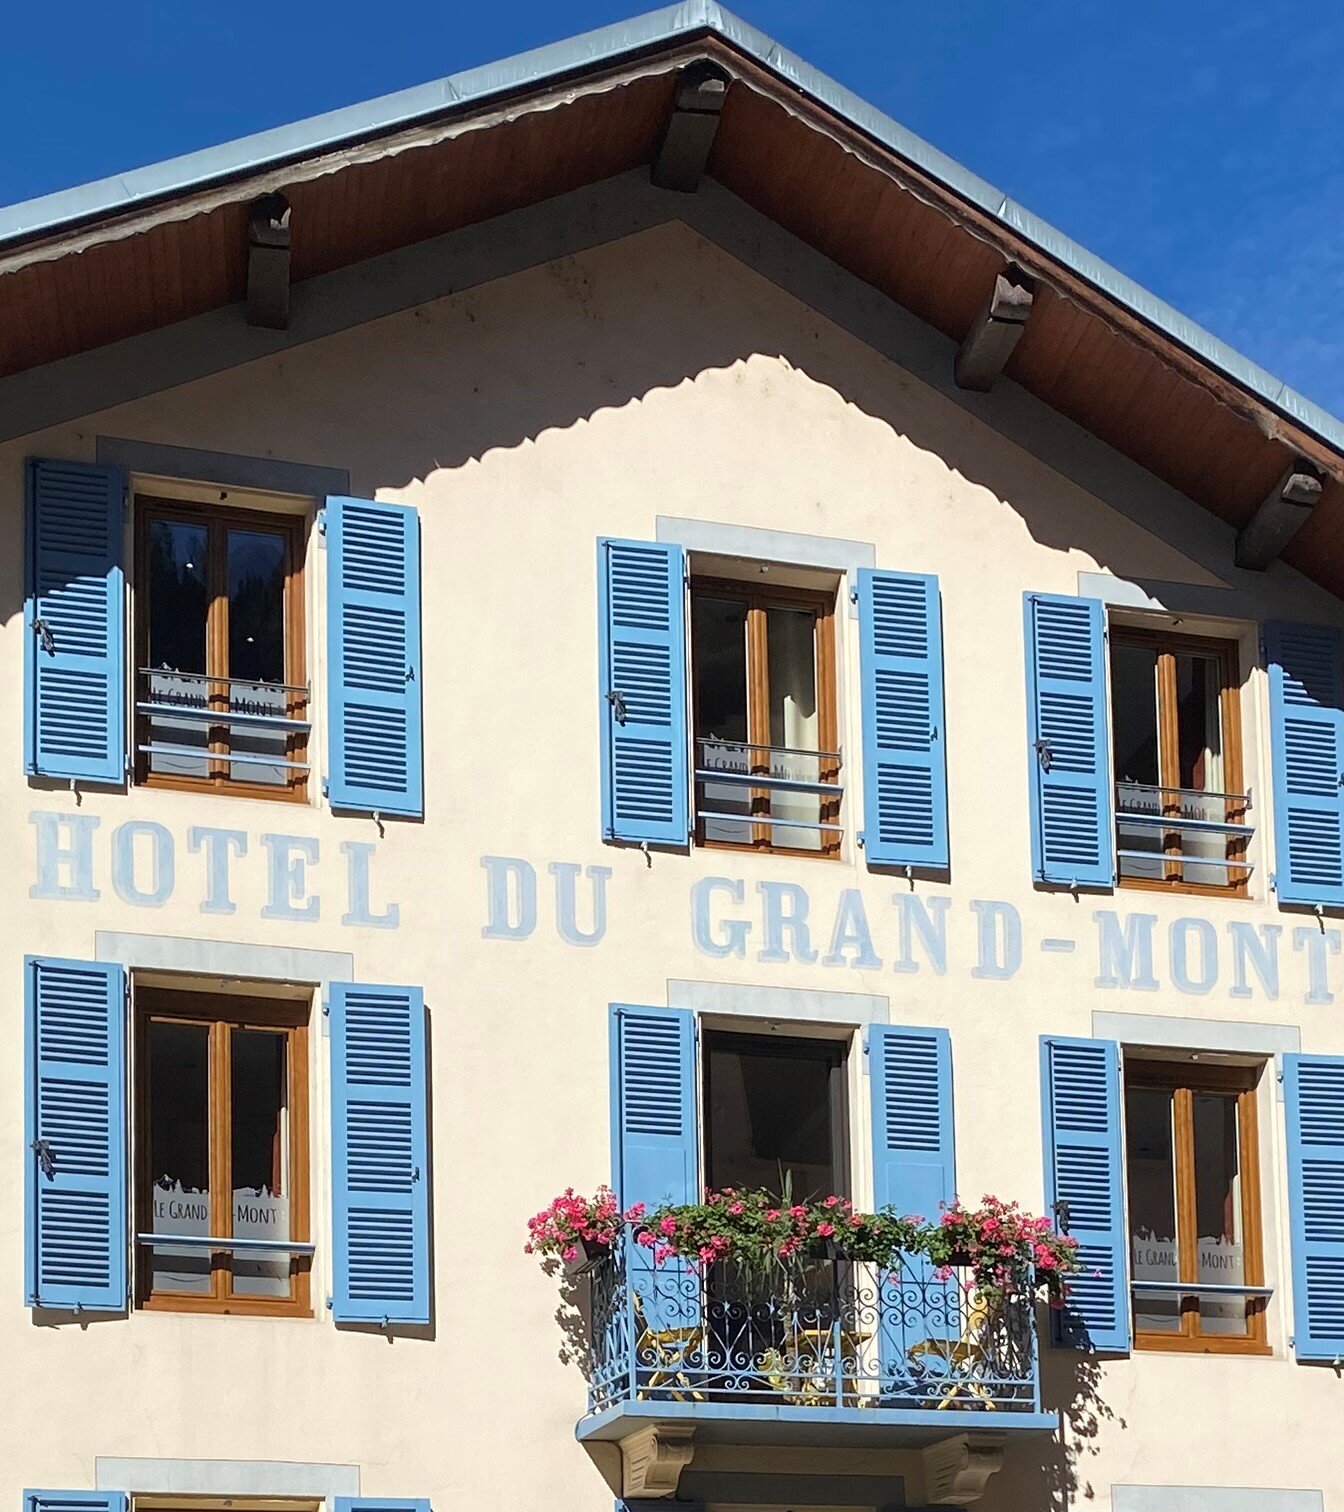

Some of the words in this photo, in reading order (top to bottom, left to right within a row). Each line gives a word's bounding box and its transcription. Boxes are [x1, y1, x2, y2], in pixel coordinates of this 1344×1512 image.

[235, 697, 274, 716] MONT
[28, 811, 400, 928] HOTEL
[480, 855, 613, 946] DU
[690, 875, 1343, 1005] GRAND-MONT
[154, 1201, 165, 1218] LE
[169, 1201, 207, 1220] GRAND
[237, 1205, 277, 1224] MONT
[1202, 1252, 1234, 1269] MONT
